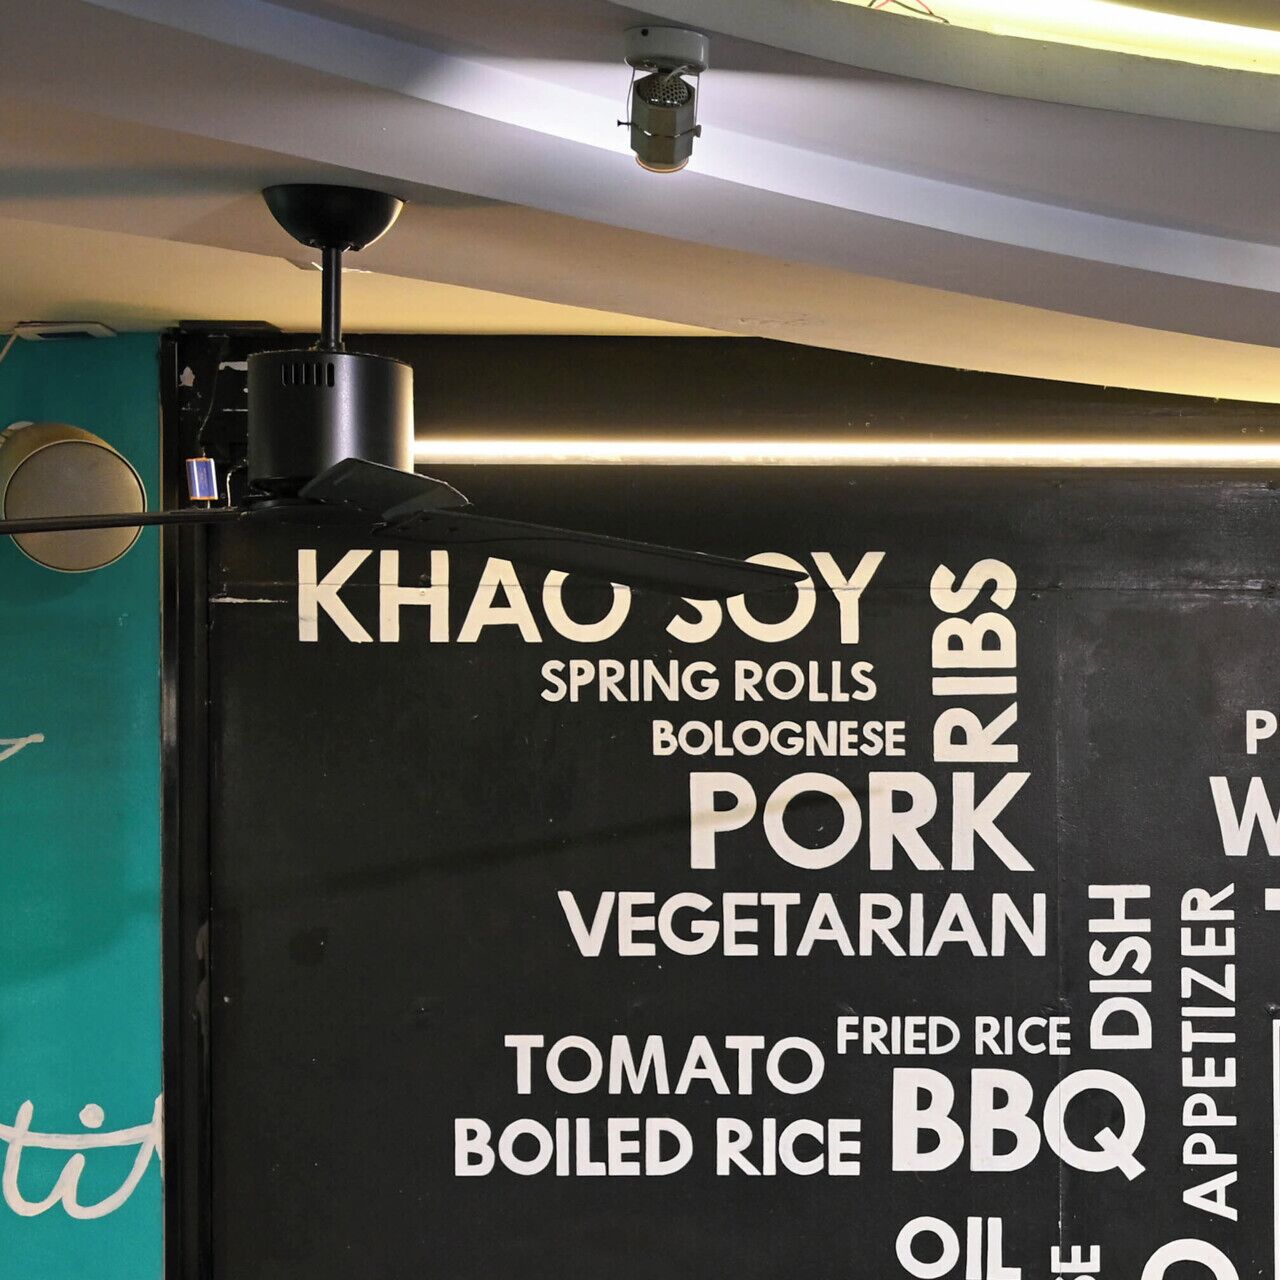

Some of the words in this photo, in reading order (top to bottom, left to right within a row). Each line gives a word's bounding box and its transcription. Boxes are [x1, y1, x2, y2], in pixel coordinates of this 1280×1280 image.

[297, 548, 632, 643] KHAO
[541, 659, 720, 702] SPRING
[734, 660, 877, 702] ROLLS
[930, 558, 1018, 763] RIBS
[652, 719, 906, 757] BOLOGNESE
[689, 771, 1035, 872] PORK
[557, 892, 1047, 957] VEGETARIAN
[1088, 884, 1153, 1050] DISH
[504, 1034, 825, 1095] TOMATO
[837, 1015, 961, 1055] FRIED
[975, 1015, 1071, 1056] RICE
[1180, 883, 1238, 1222] APPETIZER
[454, 1117, 694, 1177] BOILED
[716, 1117, 861, 1176] RICE
[891, 1067, 1146, 1181] BBQ
